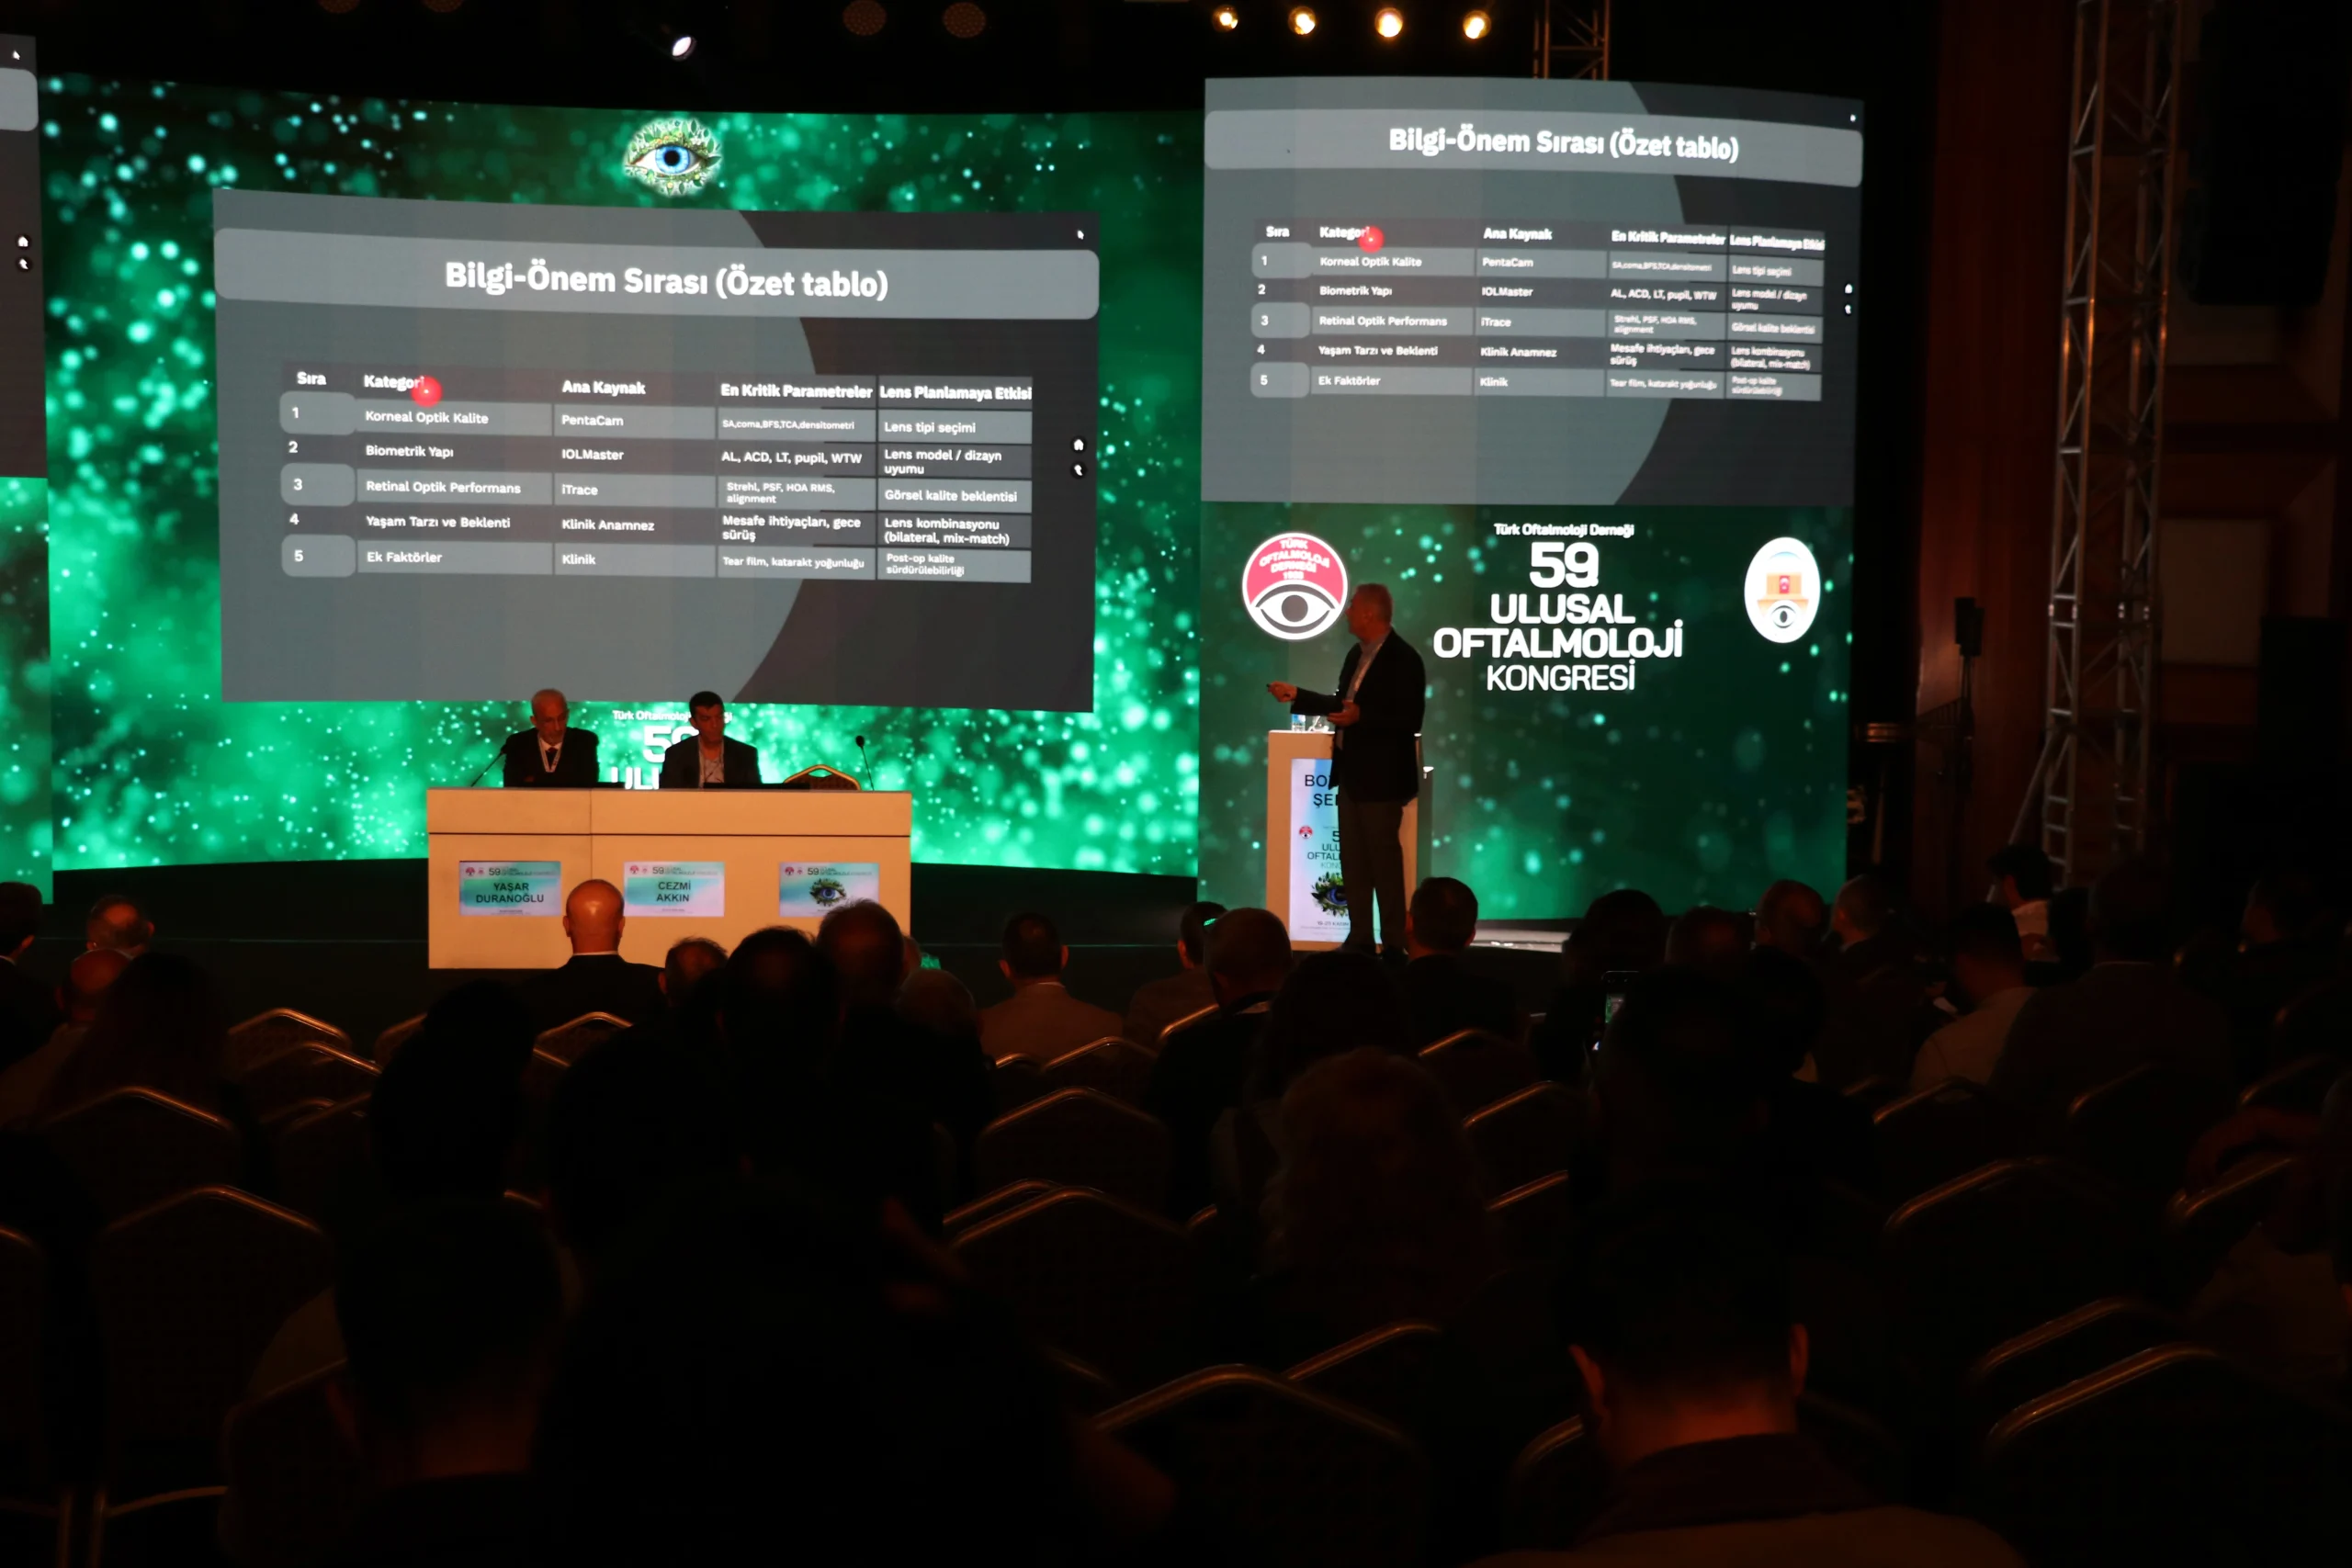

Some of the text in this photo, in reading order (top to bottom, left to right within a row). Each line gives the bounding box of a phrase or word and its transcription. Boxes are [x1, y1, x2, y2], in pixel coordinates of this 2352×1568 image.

[1390, 124, 1738, 163] Bilgi-Önem Sırası (Özet tablo)
[1266, 226, 1289, 237] Sıra
[1484, 228, 1553, 242] Ana Kaynak
[1611, 231, 1626, 242] En
[1628, 231, 1658, 243] Kritik
[1261, 255, 1267, 265] 1
[1320, 257, 1422, 268] Korneal Optik Kalite
[1483, 257, 1533, 267] PentaCam
[447, 259, 888, 301] Bilgi-Önem Sırası (Özet tablo)
[1259, 285, 1265, 294] 2
[1320, 286, 1392, 297] Biometrik Yapı
[1482, 287, 1532, 297] IOLMaster
[1611, 288, 1626, 299] AL,
[1628, 289, 1651, 299] ACD,
[1261, 316, 1268, 325] 3
[1319, 316, 1447, 327] Retinal Optik Performans
[1481, 318, 1511, 327] iTrace
[1257, 344, 1265, 354] 4
[1319, 345, 1351, 356] Yaşam
[1354, 345, 1378, 355] Tarzı
[1396, 346, 1438, 356] Beklenti
[1481, 347, 1557, 357] Klinik Anamnez
[298, 372, 326, 385] Sıra
[364, 375, 424, 391] Kategori
[1261, 376, 1268, 385] 5
[1318, 376, 1380, 386] Ek Faktörler
[1480, 378, 1508, 387] Klinik
[562, 380, 646, 397] Ana Kaynak
[721, 384, 873, 398] En Kritik Parametreler
[880, 386, 1032, 402] Lens Planlamaya Etkisi
[292, 407, 299, 418] 1
[366, 411, 489, 424] Korneal Optik Kalite
[561, 415, 624, 426] PentaCam
[885, 423, 976, 435] Lens tipi seçimi
[288, 441, 298, 453] 2
[366, 445, 454, 459] Biometrik Yapı
[561, 449, 624, 460] IOLMaster
[721, 452, 862, 465] AL, ACD, LT, pupil, WTW
[885, 450, 912, 459] Lens
[916, 450, 953, 460] model
[965, 450, 1001, 464] dizayn
[885, 465, 924, 476] uyumu
[294, 479, 302, 490] 3
[368, 481, 521, 494] Retinal Optik Performans
[561, 485, 598, 495] iTrace
[727, 482, 760, 491] Strehl,
[763, 483, 783, 492] PSF,
[810, 484, 834, 493] RMS,
[727, 494, 776, 504] alignment
[885, 490, 1017, 502] Görsel kalite beklentisi
[290, 514, 300, 525] 4
[368, 516, 405, 528] Yaşam
[410, 516, 438, 527] Tarzı
[461, 517, 510, 528] Beklenti
[562, 519, 654, 531] Klinik Anamnez
[723, 515, 861, 529] Mesafe ihtiyaçları, gece
[885, 518, 999, 532] Lens kombinasyonu
[723, 530, 755, 542] sürüş
[1494, 524, 1634, 538] Türk Oftalmoloji Derneği
[885, 532, 1010, 547] (bilateral, mix-match)
[294, 550, 303, 562] 5
[368, 552, 442, 562] Ek Faktörler
[563, 555, 595, 565] Klinik
[887, 553, 955, 563] Post-op kalite
[723, 557, 865, 570] Tear film, katarakt yoğunluğu
[1490, 594, 1635, 624] ULUSAL
[1433, 619, 1683, 658] OFTALMOLOJİ
[1487, 659, 1634, 691] KONGRESİ
[613, 710, 634, 720] Türk
[494, 883, 529, 891] YAŞAR
[659, 880, 691, 890] CEZMİ
[476, 894, 544, 902] DURANOĞLU
